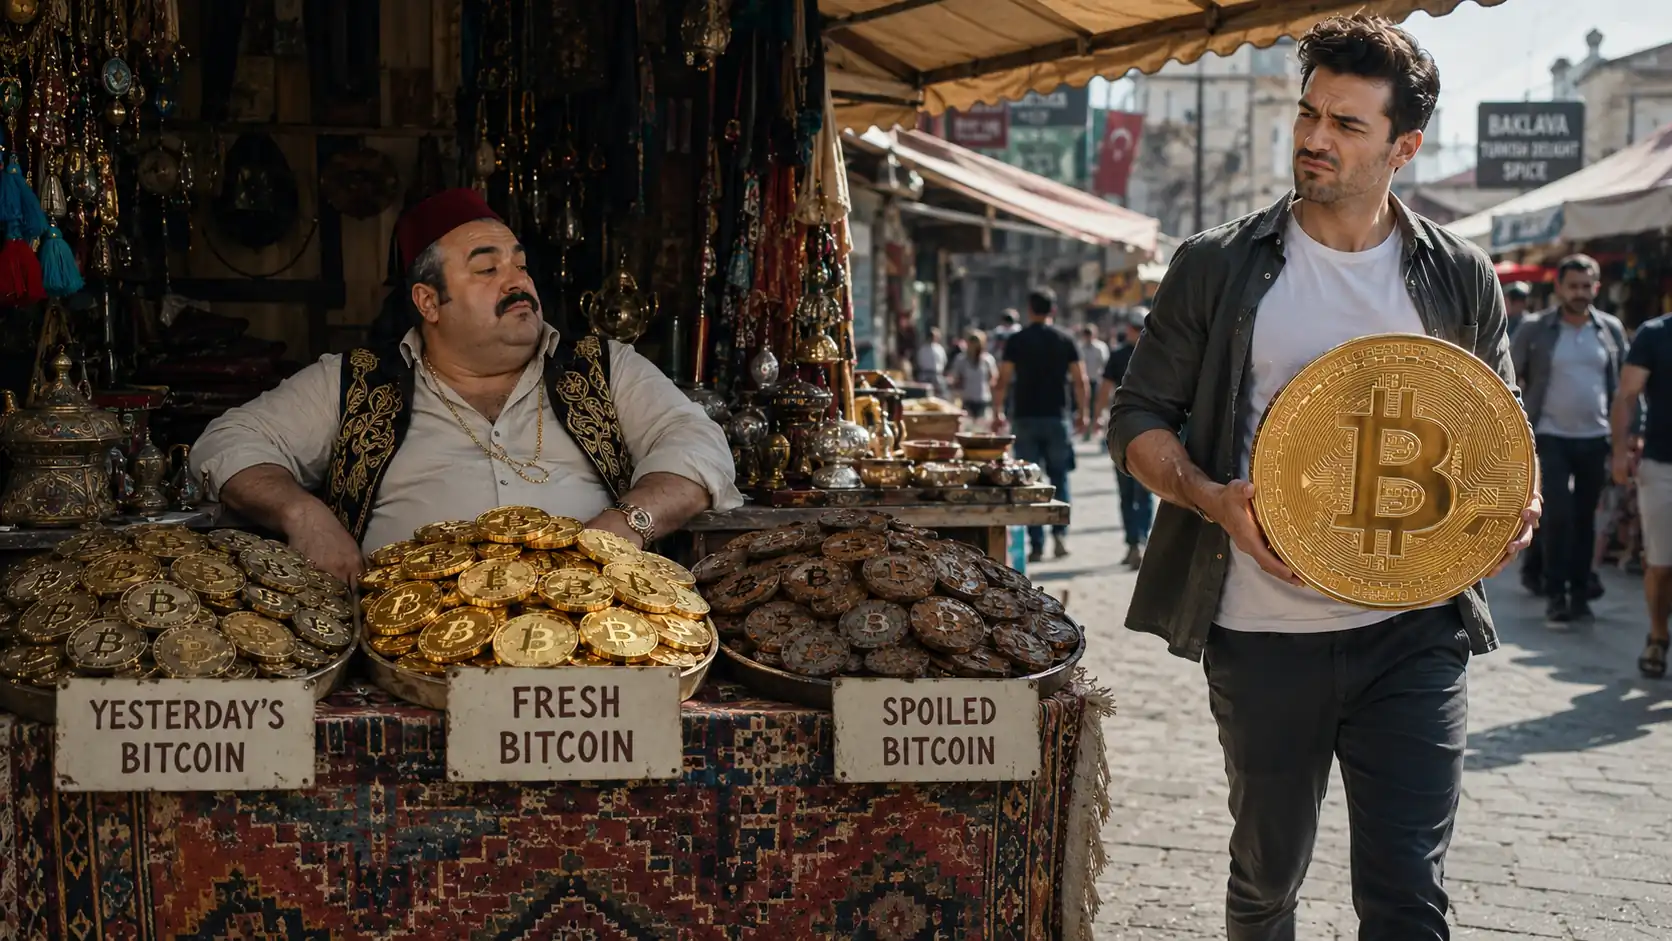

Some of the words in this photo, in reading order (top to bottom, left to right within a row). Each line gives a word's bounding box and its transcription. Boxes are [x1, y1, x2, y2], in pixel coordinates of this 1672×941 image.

[1502, 161, 1548, 181] SPICE
[512, 685, 620, 719] FRESH
[882, 696, 997, 727] SPOILED
[121, 741, 246, 774] BITCOIN
[499, 730, 634, 764] BITCOIN
[882, 735, 995, 766] BITCOIN
